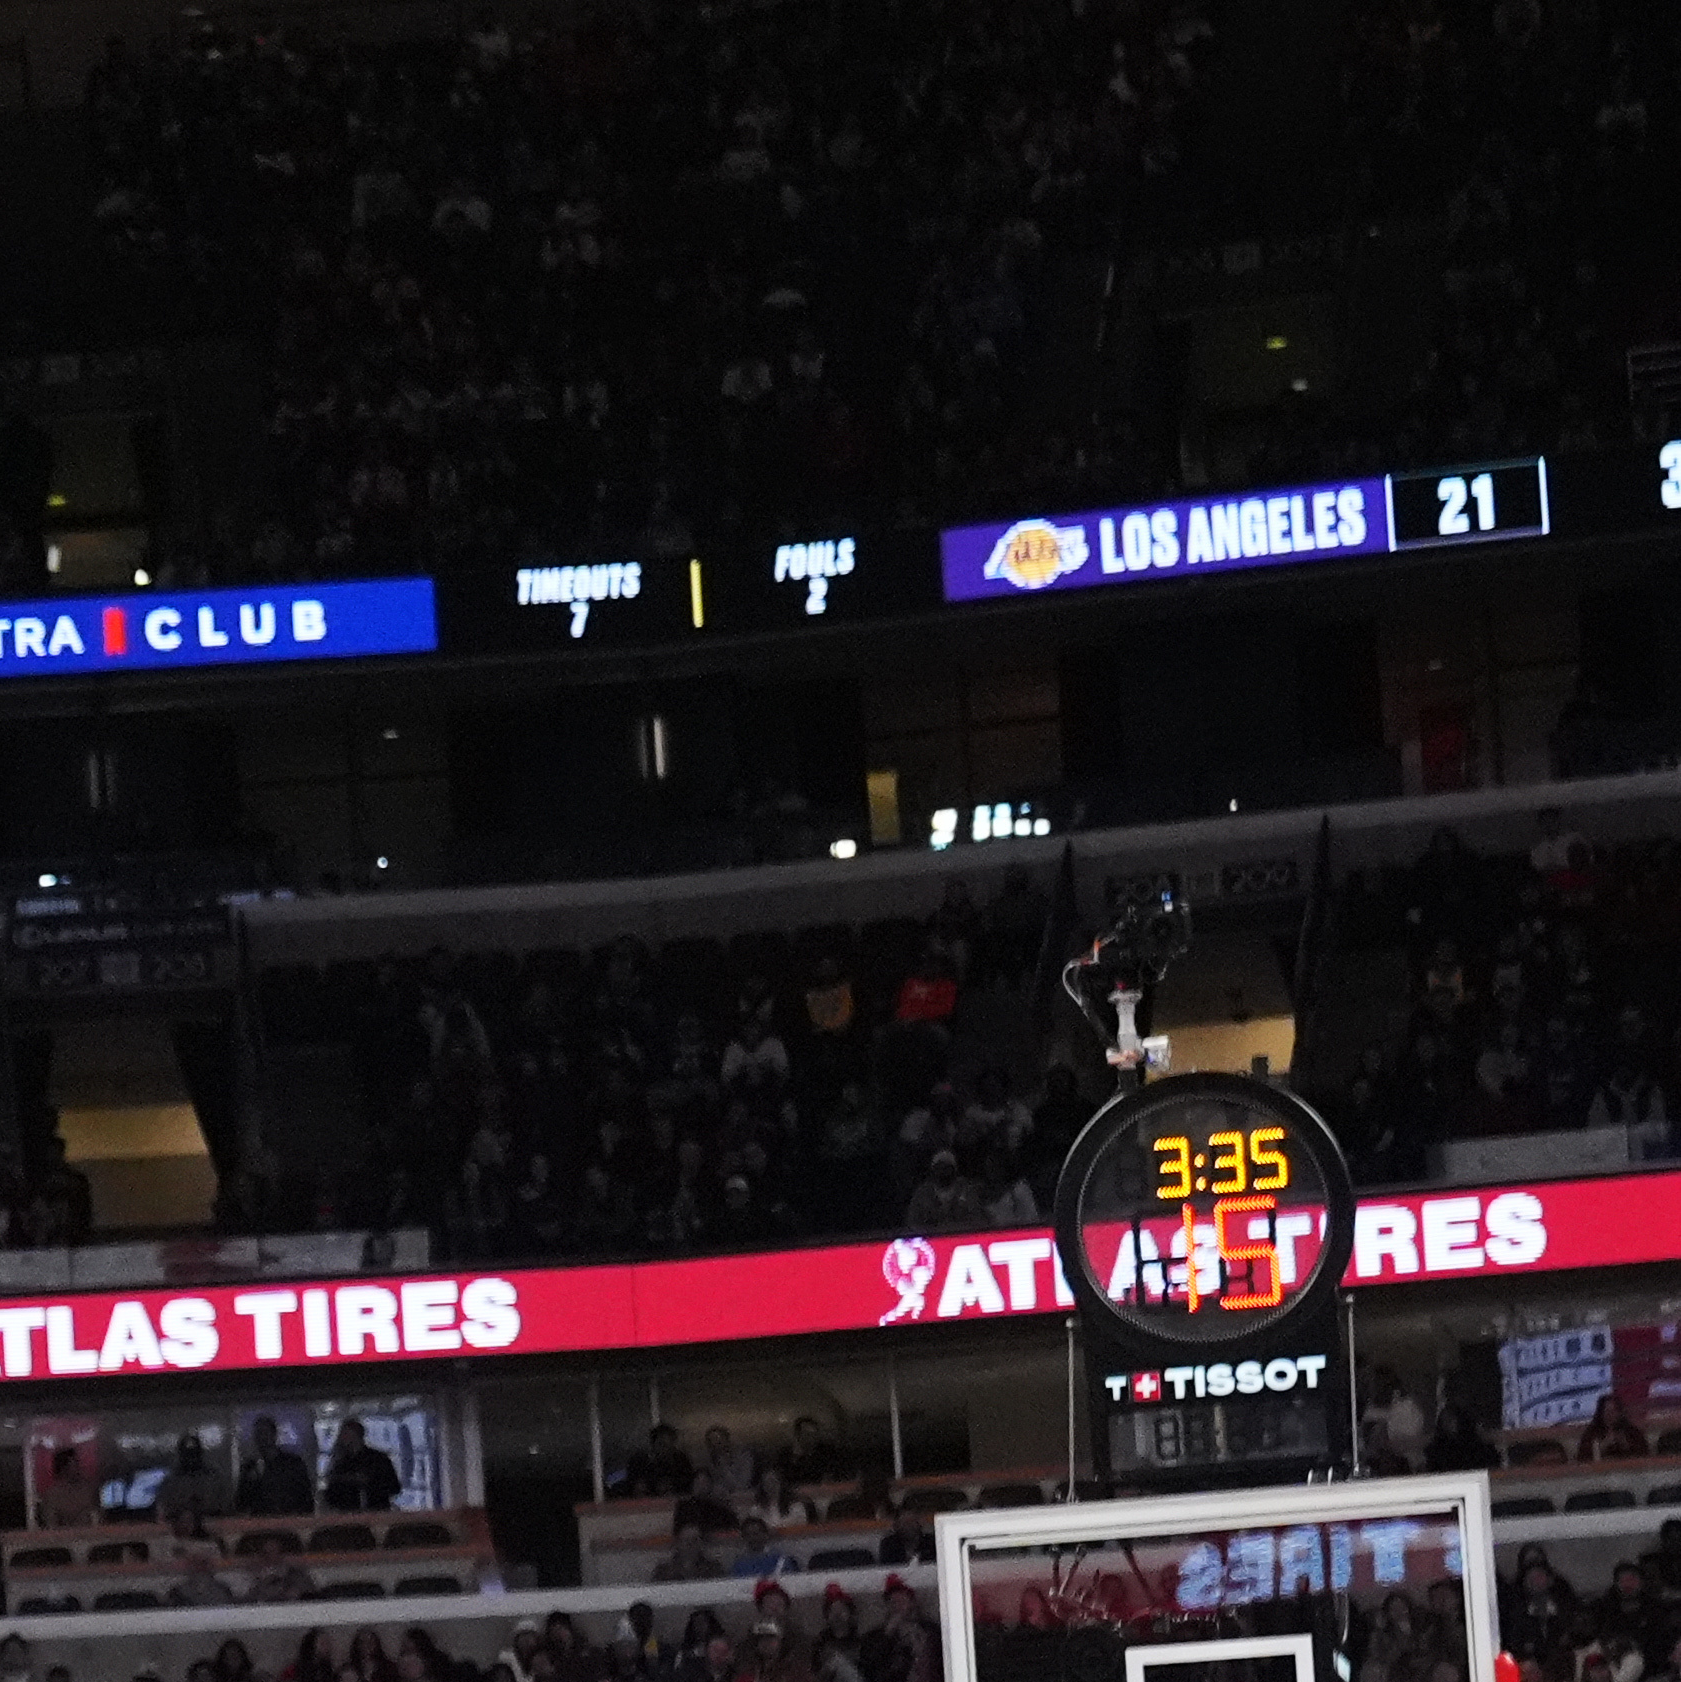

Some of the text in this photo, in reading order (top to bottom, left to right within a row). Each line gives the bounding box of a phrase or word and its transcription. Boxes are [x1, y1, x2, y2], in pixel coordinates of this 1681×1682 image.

[1099, 508, 1180, 574] LOS
[1187, 487, 1367, 565] ANGELES
[1437, 474, 1495, 535] 21
[517, 562, 641, 605] TIMEOUTS
[774, 538, 855, 582] FOULS
[570, 601, 590, 638] 7
[805, 577, 828, 615] 2
[144, 599, 327, 651] CLUB
[1153, 1126, 1290, 1200] 3:35
[1247, 1192, 1548, 1286] TRES
[234, 1277, 521, 1361] TIRES
[1163, 1354, 1327, 1400] TISSOT
